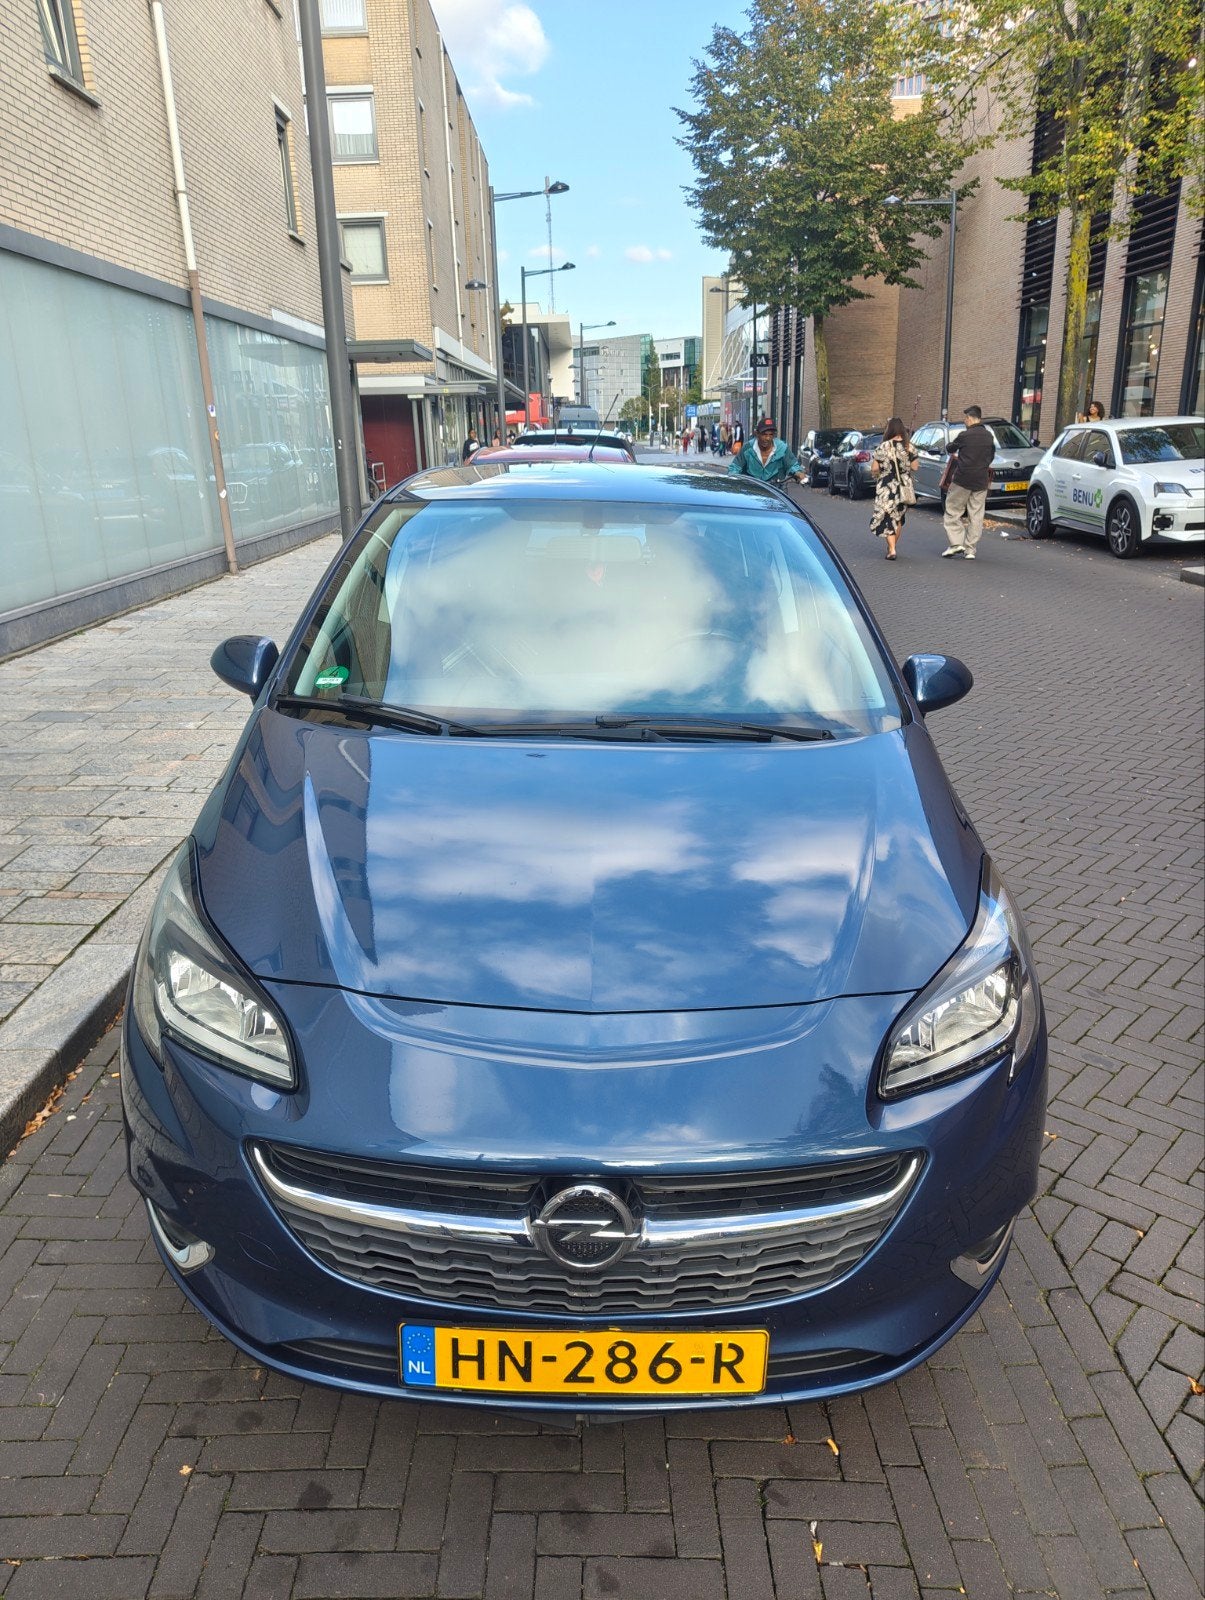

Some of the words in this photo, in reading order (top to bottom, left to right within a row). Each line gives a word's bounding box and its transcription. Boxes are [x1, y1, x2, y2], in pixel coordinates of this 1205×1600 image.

[1072, 488, 1094, 507] BENU
[408, 1360, 431, 1375] NL
[450, 1337, 746, 1385] HN-286-R
